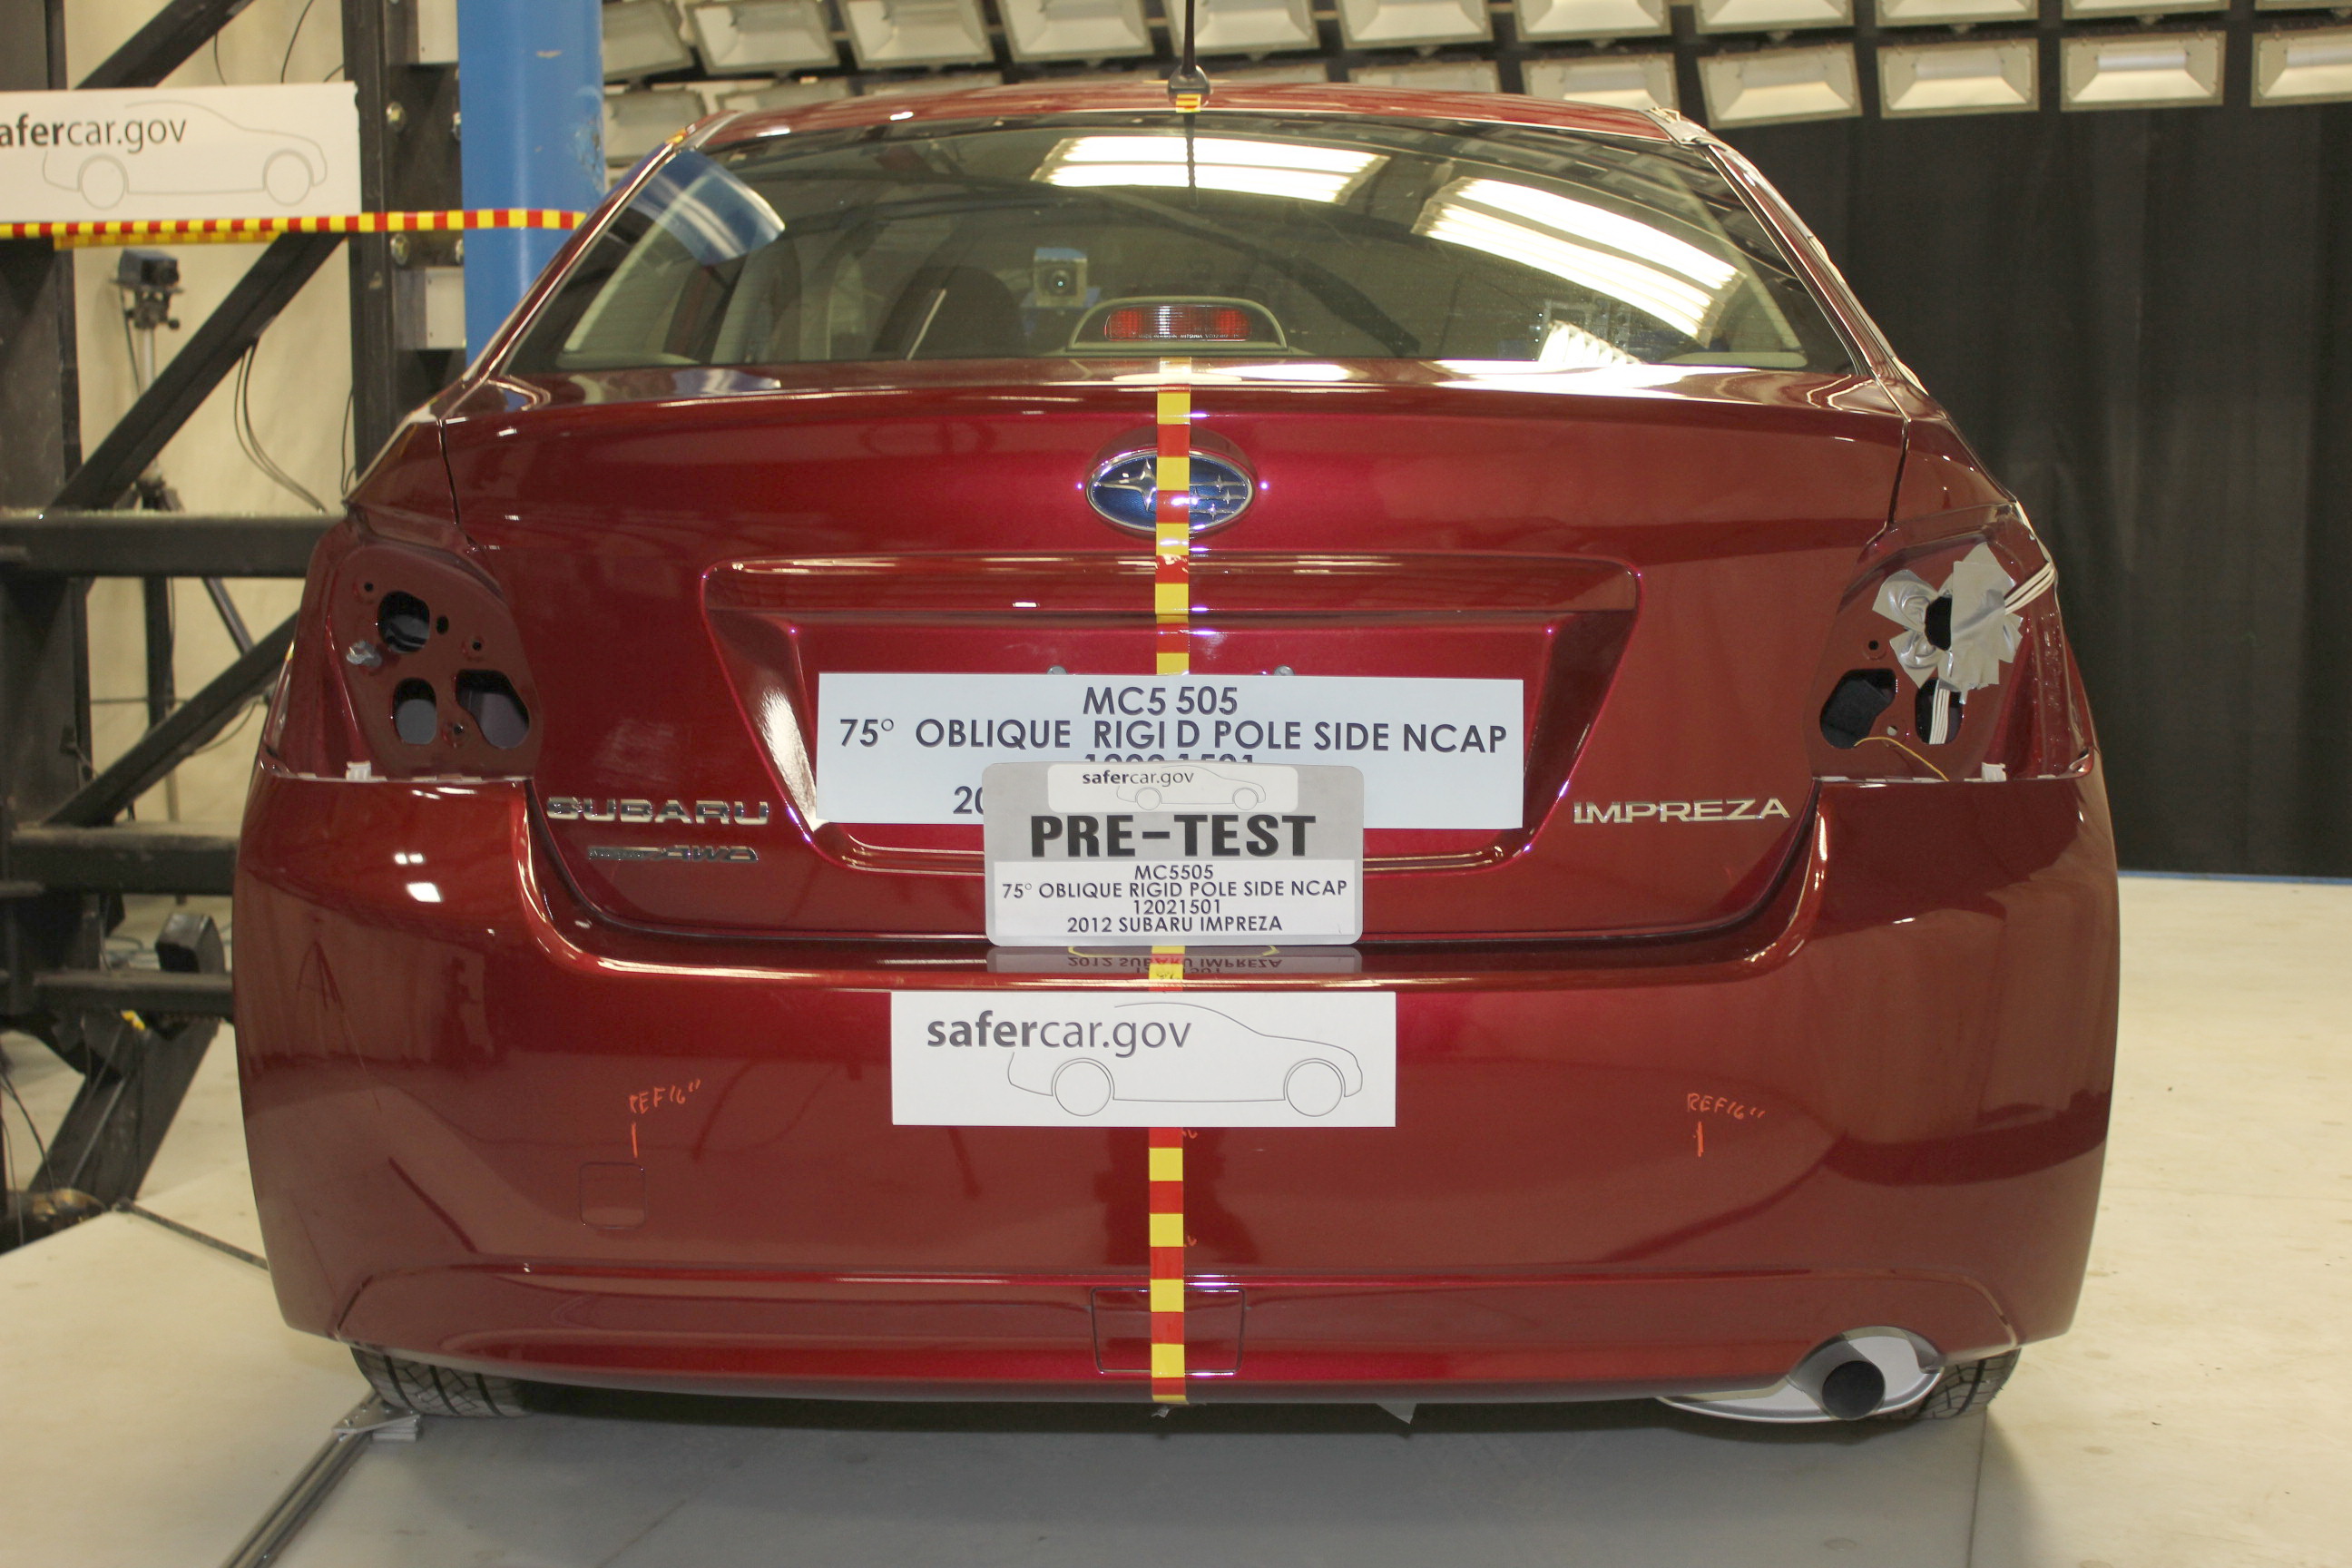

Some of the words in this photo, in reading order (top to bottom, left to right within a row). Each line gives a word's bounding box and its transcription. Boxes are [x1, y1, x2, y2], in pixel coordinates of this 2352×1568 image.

[0, 113, 186, 154] afercar.gov
[840, 719, 894, 747] 75°
[916, 719, 1070, 750] OBLIQUE
[1215, 720, 1300, 750] POLE
[1314, 721, 1388, 750] SIDE
[1404, 724, 1506, 753] NCAP
[1083, 770, 1193, 787] safercar.gov
[547, 797, 768, 825] SUBARU
[1573, 798, 1790, 824] IMPREZA
[1032, 815, 1316, 858] PRE-TEST
[1135, 865, 1213, 880] MC5505
[1003, 884, 1031, 898] 75°
[1039, 883, 1122, 898] OBLIQUE
[1130, 882, 1181, 897] RIGID
[1191, 882, 1236, 897] POLE
[1244, 881, 1283, 896] SIDE
[1292, 880, 1347, 896] NCAP
[1134, 899, 1219, 915] 12021501
[1068, 917, 1112, 932] 2012
[1119, 917, 1192, 932] SUBARU
[1201, 916, 1282, 931] IMPREZA
[927, 1010, 1192, 1058] safercar.gov
